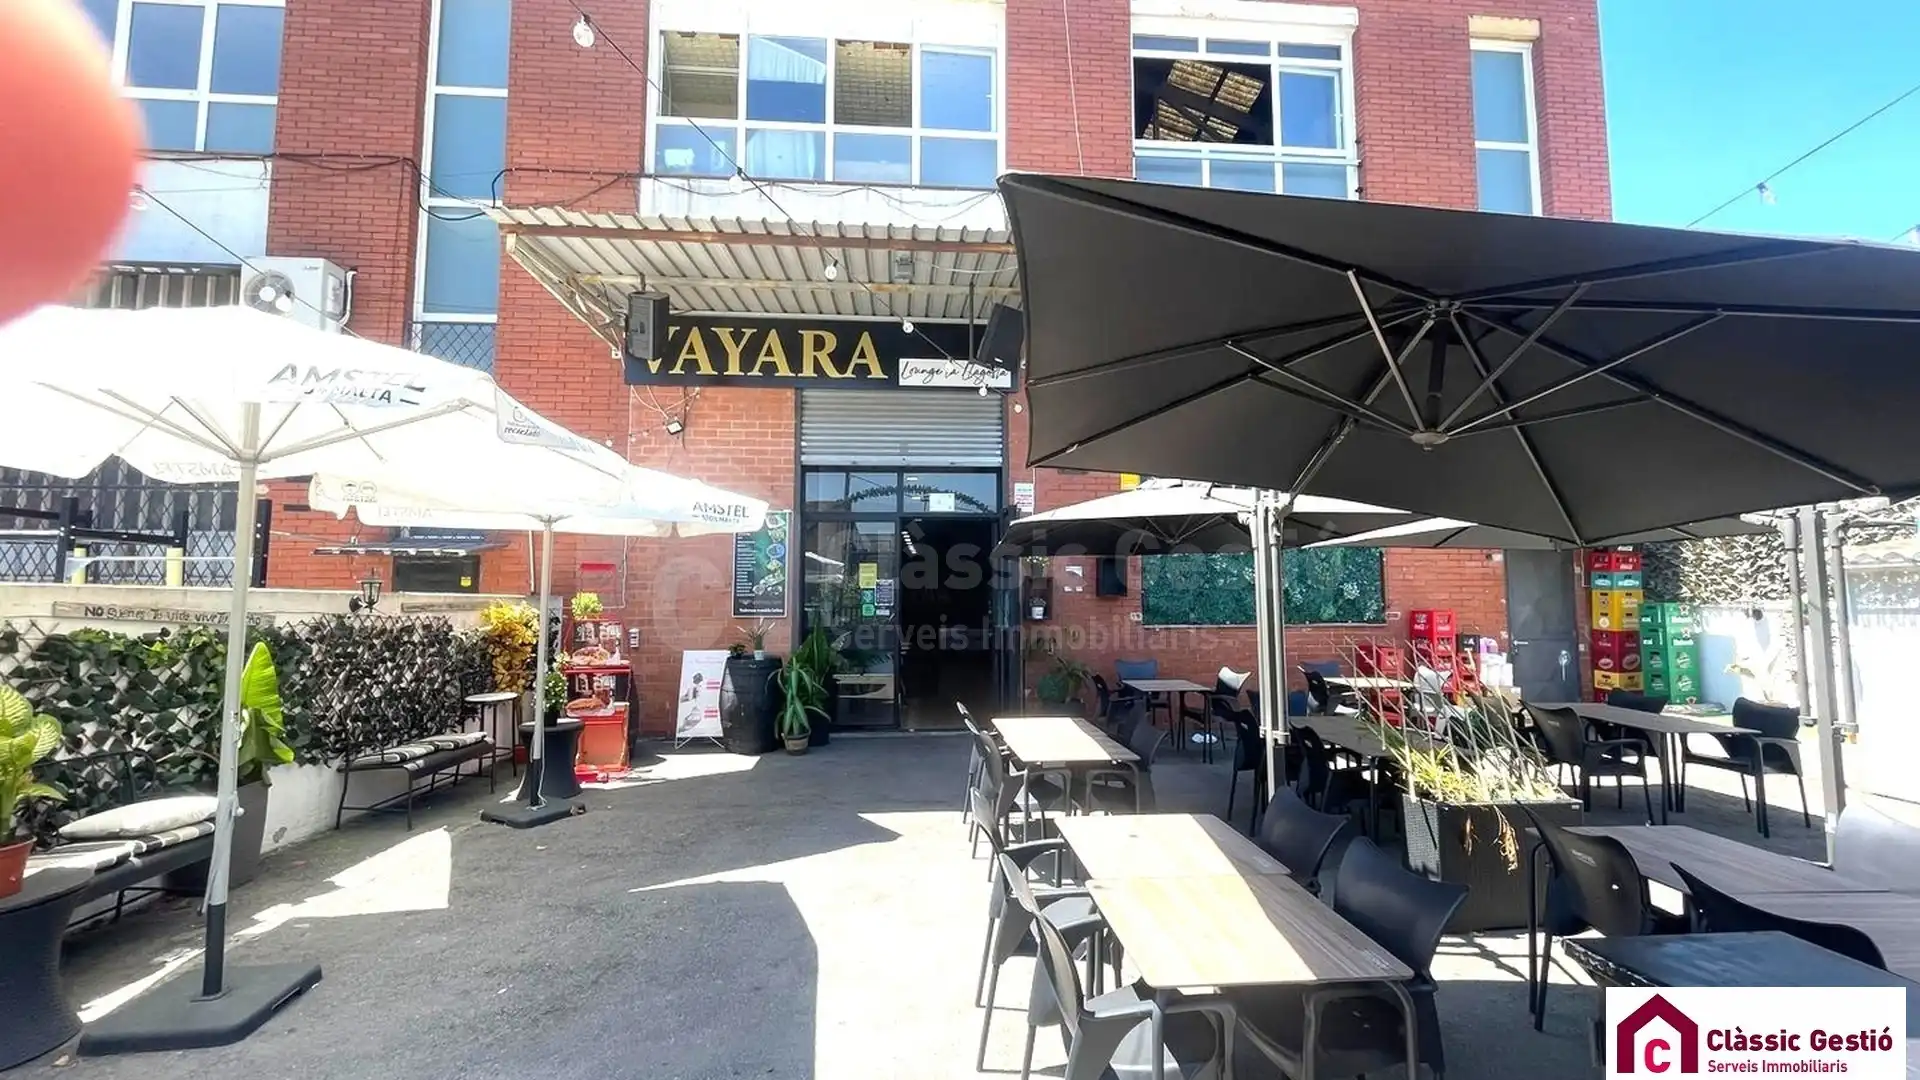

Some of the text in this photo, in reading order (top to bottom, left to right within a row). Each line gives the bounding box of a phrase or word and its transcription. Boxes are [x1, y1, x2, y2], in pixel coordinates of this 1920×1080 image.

[267, 363, 427, 393] AMSTEL
[901, 361, 943, 384] Lounge
[692, 501, 750, 518] AMSTEL
[84, 606, 104, 617] NO
